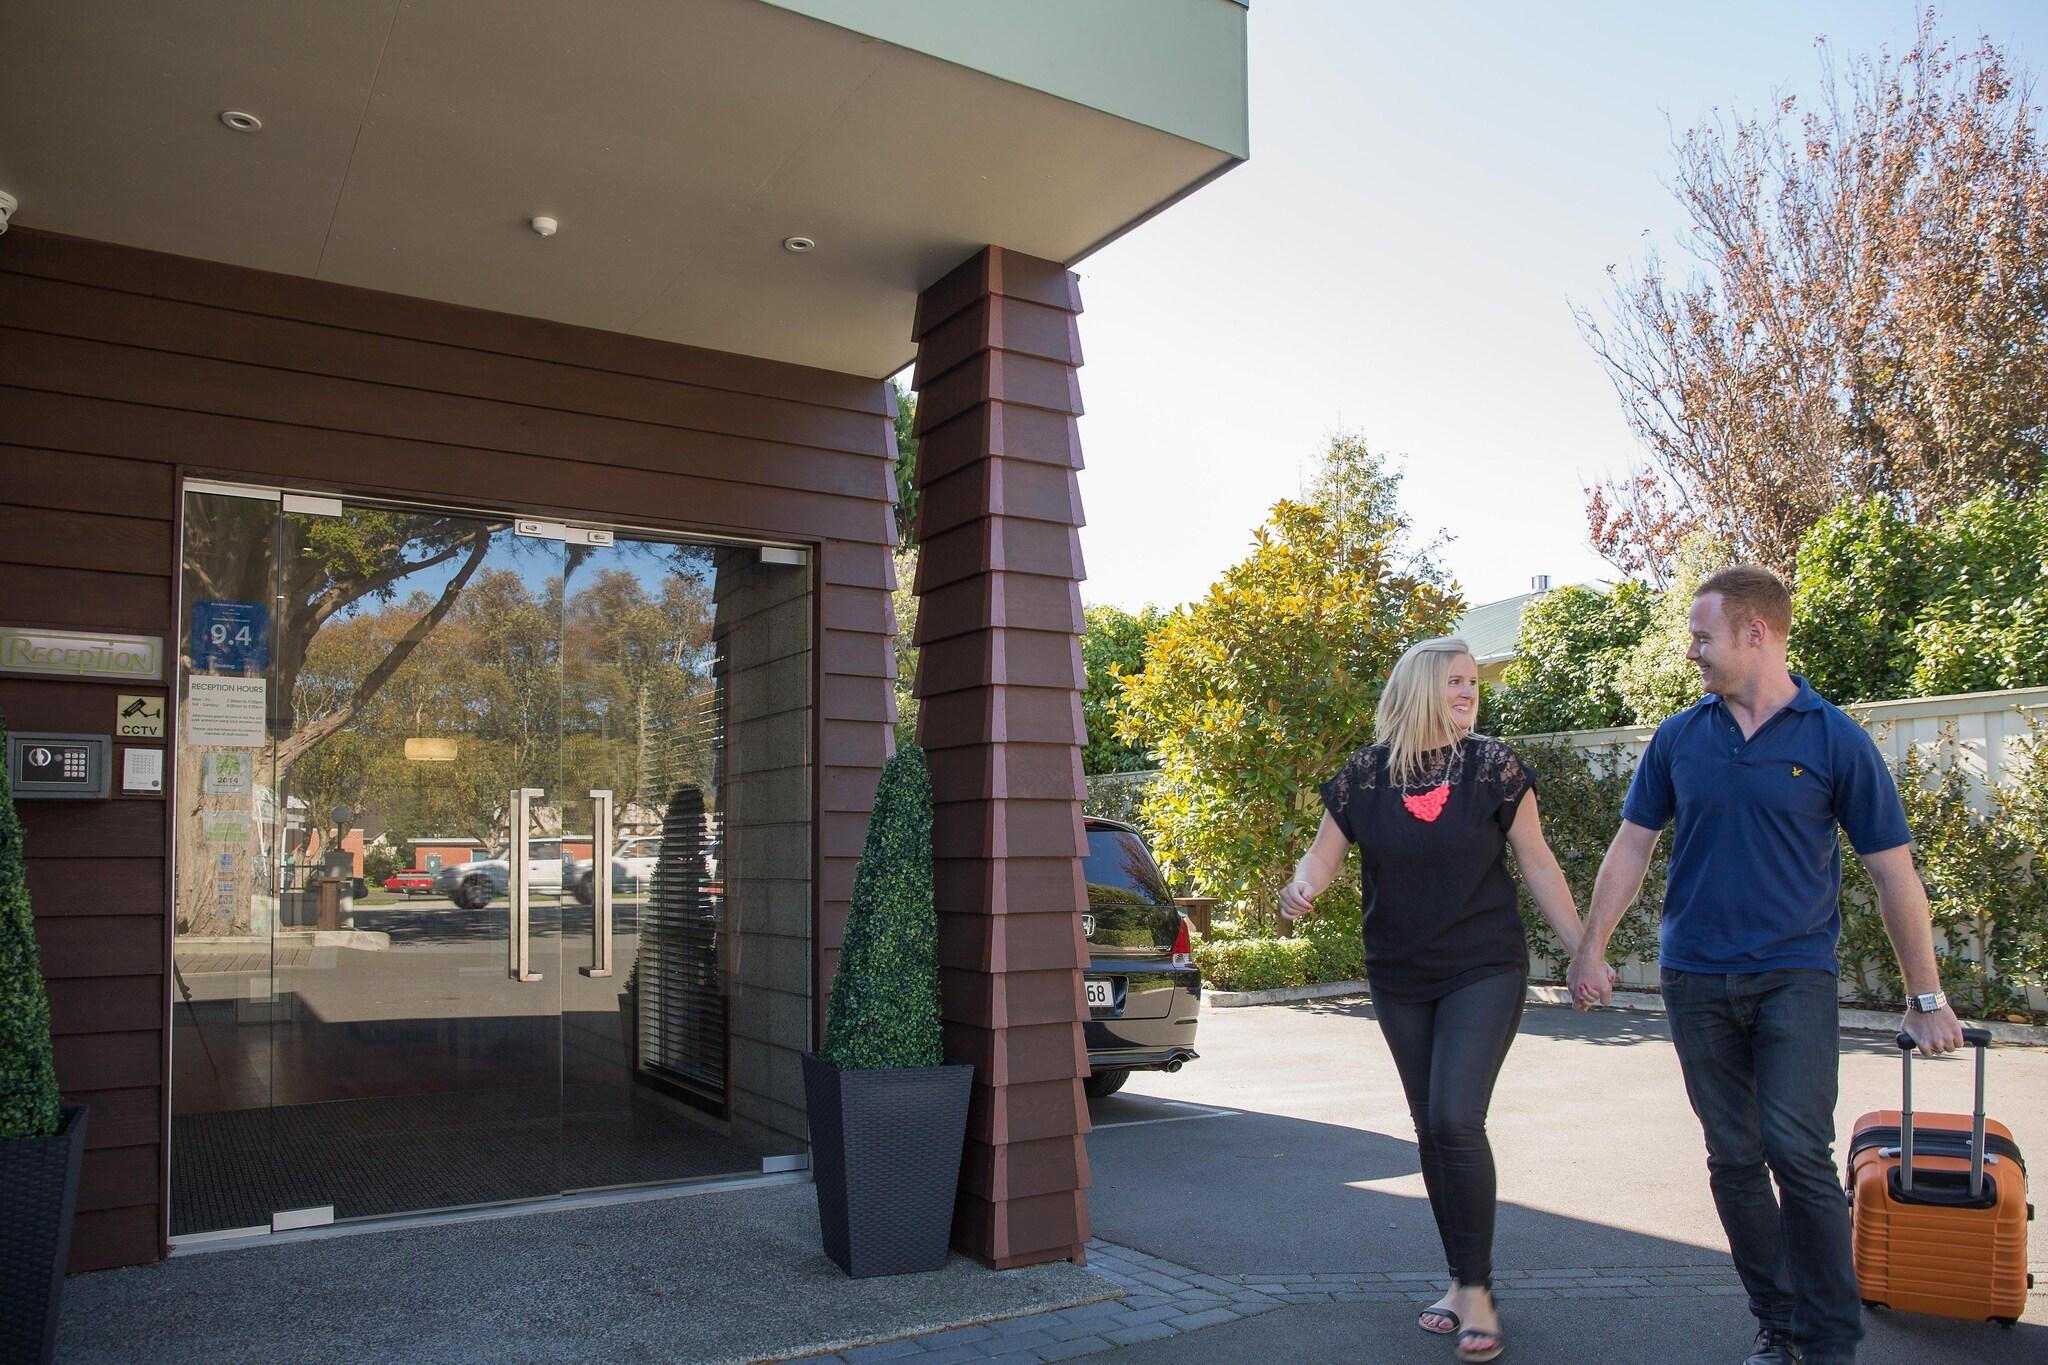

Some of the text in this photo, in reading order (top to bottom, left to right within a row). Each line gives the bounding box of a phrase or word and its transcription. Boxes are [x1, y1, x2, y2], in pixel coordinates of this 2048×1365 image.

[210, 623, 252, 646] 9.4
[191, 682, 263, 693] RECEPTION HOURS
[122, 725, 158, 735] CCTV
